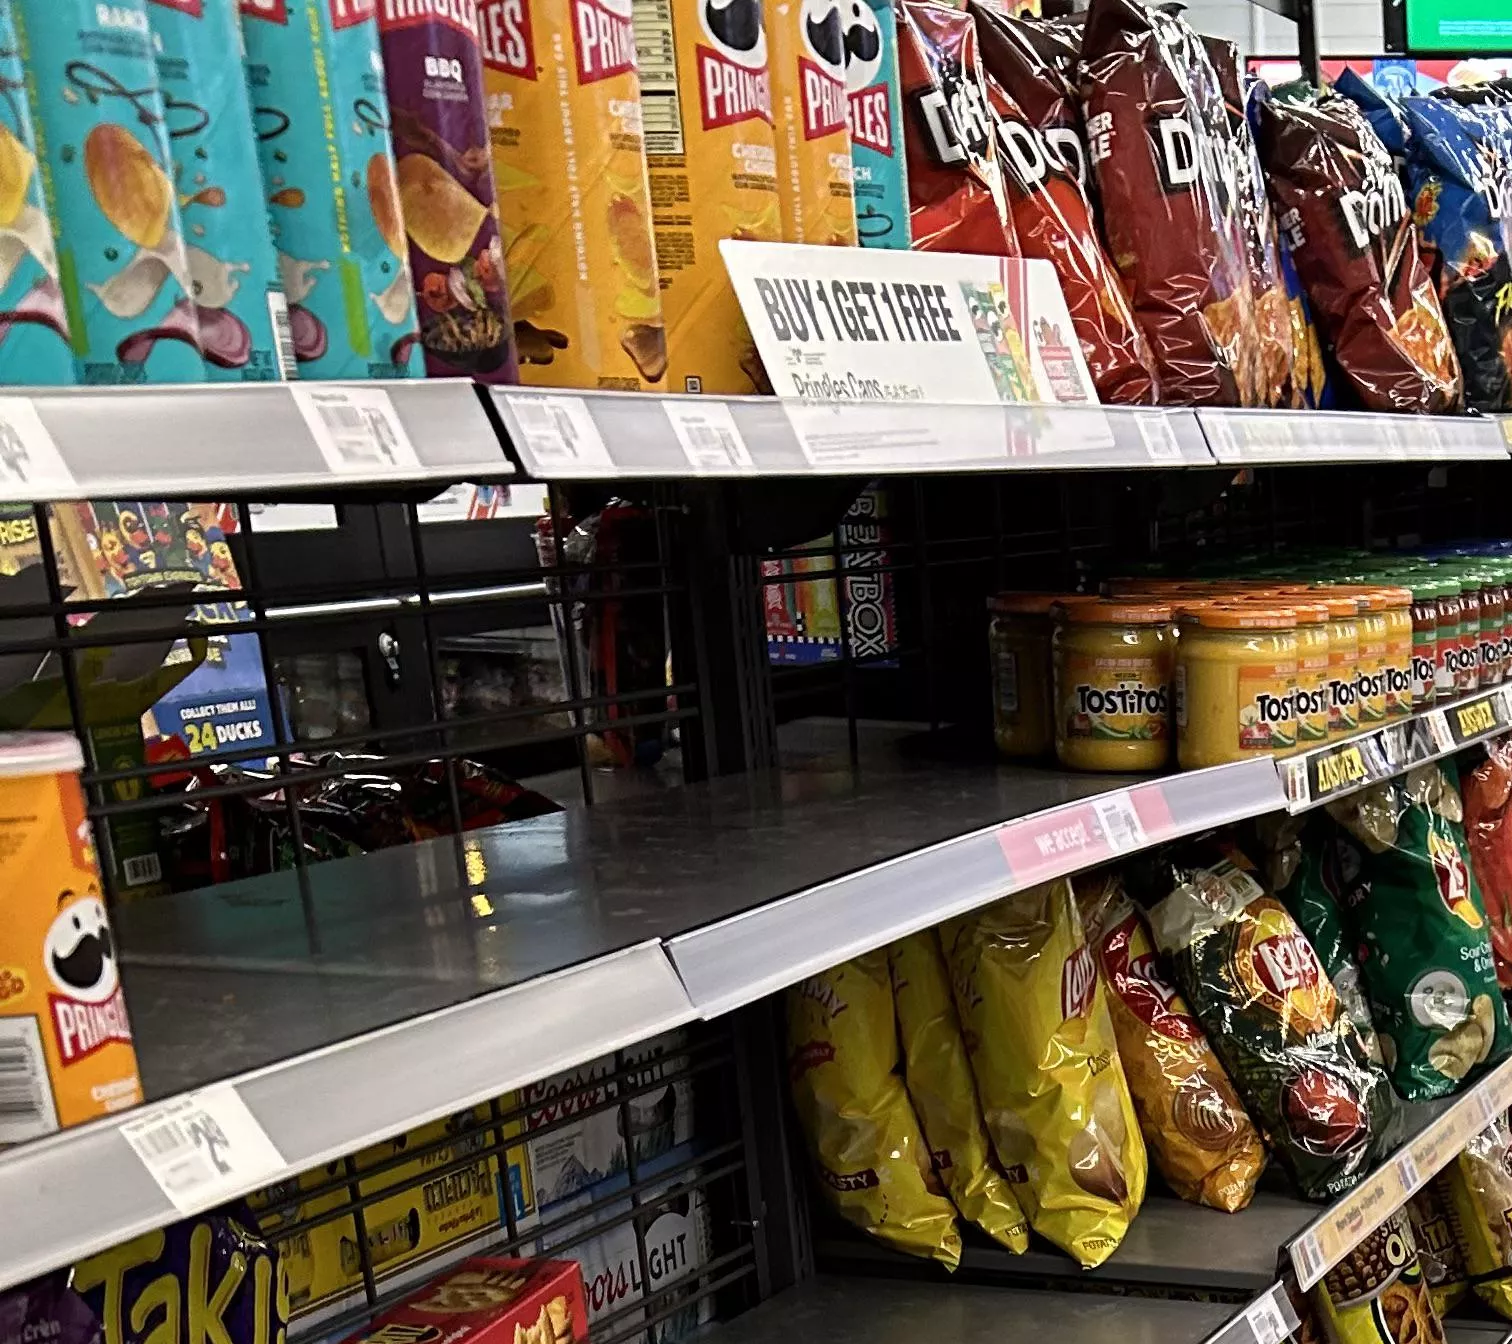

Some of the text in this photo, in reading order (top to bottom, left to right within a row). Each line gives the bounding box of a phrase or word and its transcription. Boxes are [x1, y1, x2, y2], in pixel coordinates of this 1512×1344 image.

[424, 55, 462, 82] BBQ
[754, 277, 962, 342] BUY 1 GET 1 FREE
[0, 518, 36, 546] RISE
[180, 704, 215, 721] COLLECT
[216, 702, 239, 715] THEM
[1456, 700, 1497, 738] ANSWER
[184, 720, 262, 755] 24 DUCKS
[1317, 748, 1366, 793] ANSWER
[631, 1232, 689, 1295] LGHT
